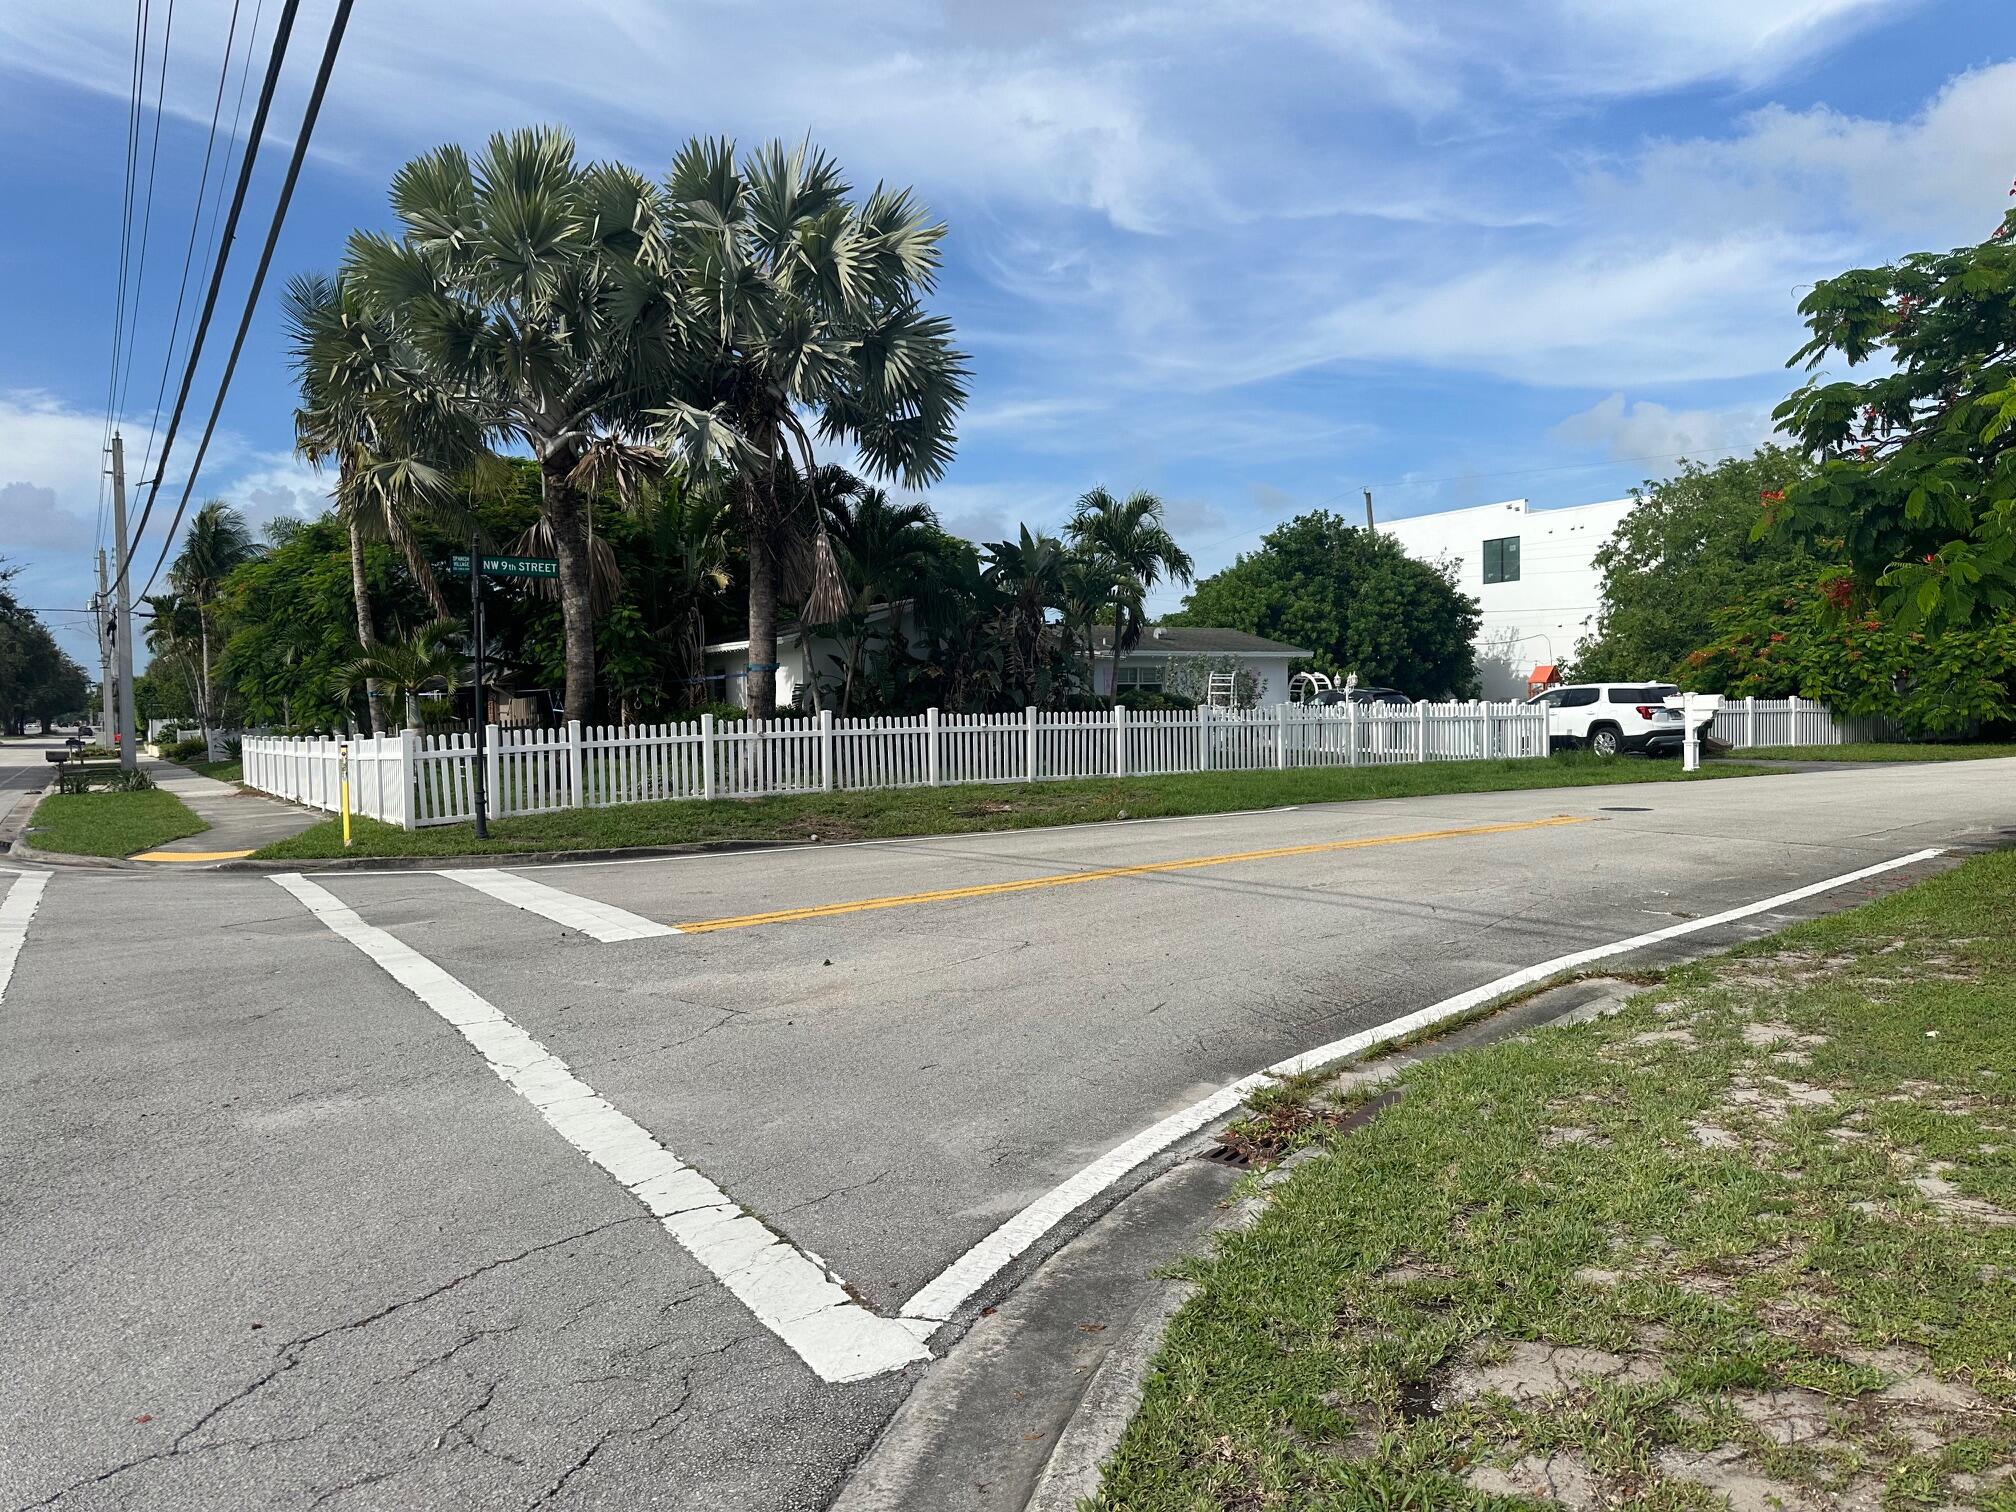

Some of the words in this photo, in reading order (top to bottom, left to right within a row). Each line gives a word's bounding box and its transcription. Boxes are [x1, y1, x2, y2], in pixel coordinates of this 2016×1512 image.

[483, 560, 500, 571] NW
[501, 561, 517, 571] 9th
[518, 562, 557, 573] STREET
